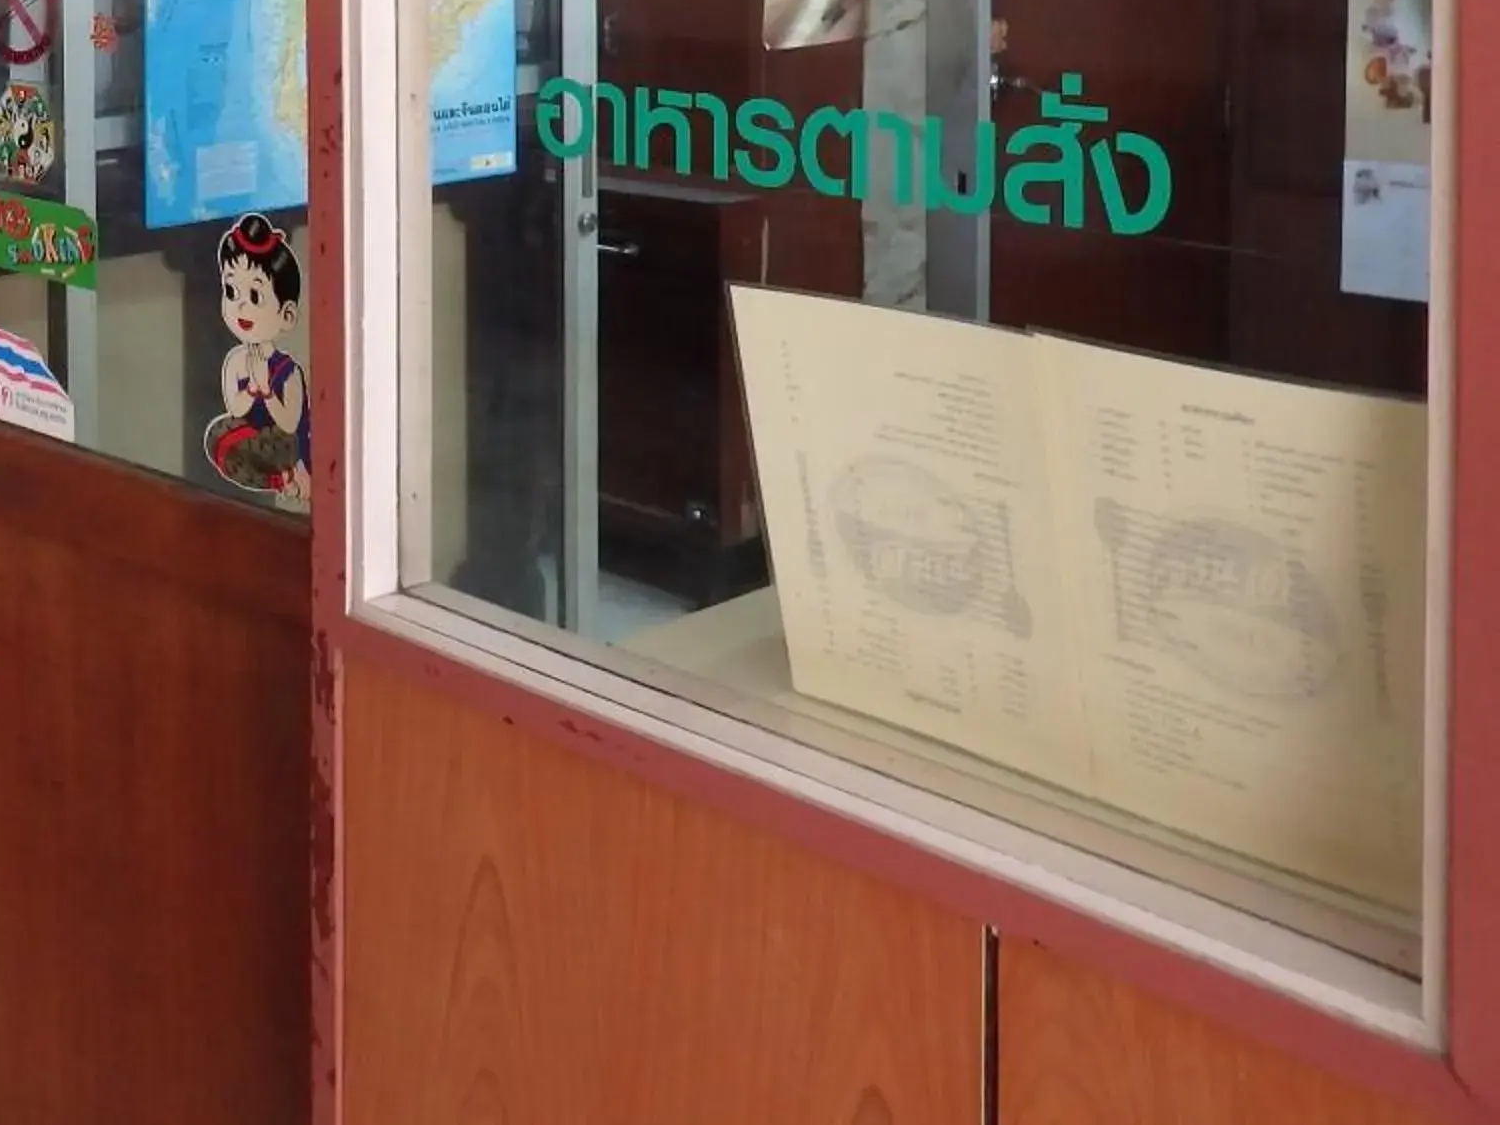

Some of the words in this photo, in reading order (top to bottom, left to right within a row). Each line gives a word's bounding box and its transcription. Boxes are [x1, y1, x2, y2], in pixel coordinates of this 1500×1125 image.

[535, 73, 1173, 236] อาหารตามสั่ง
